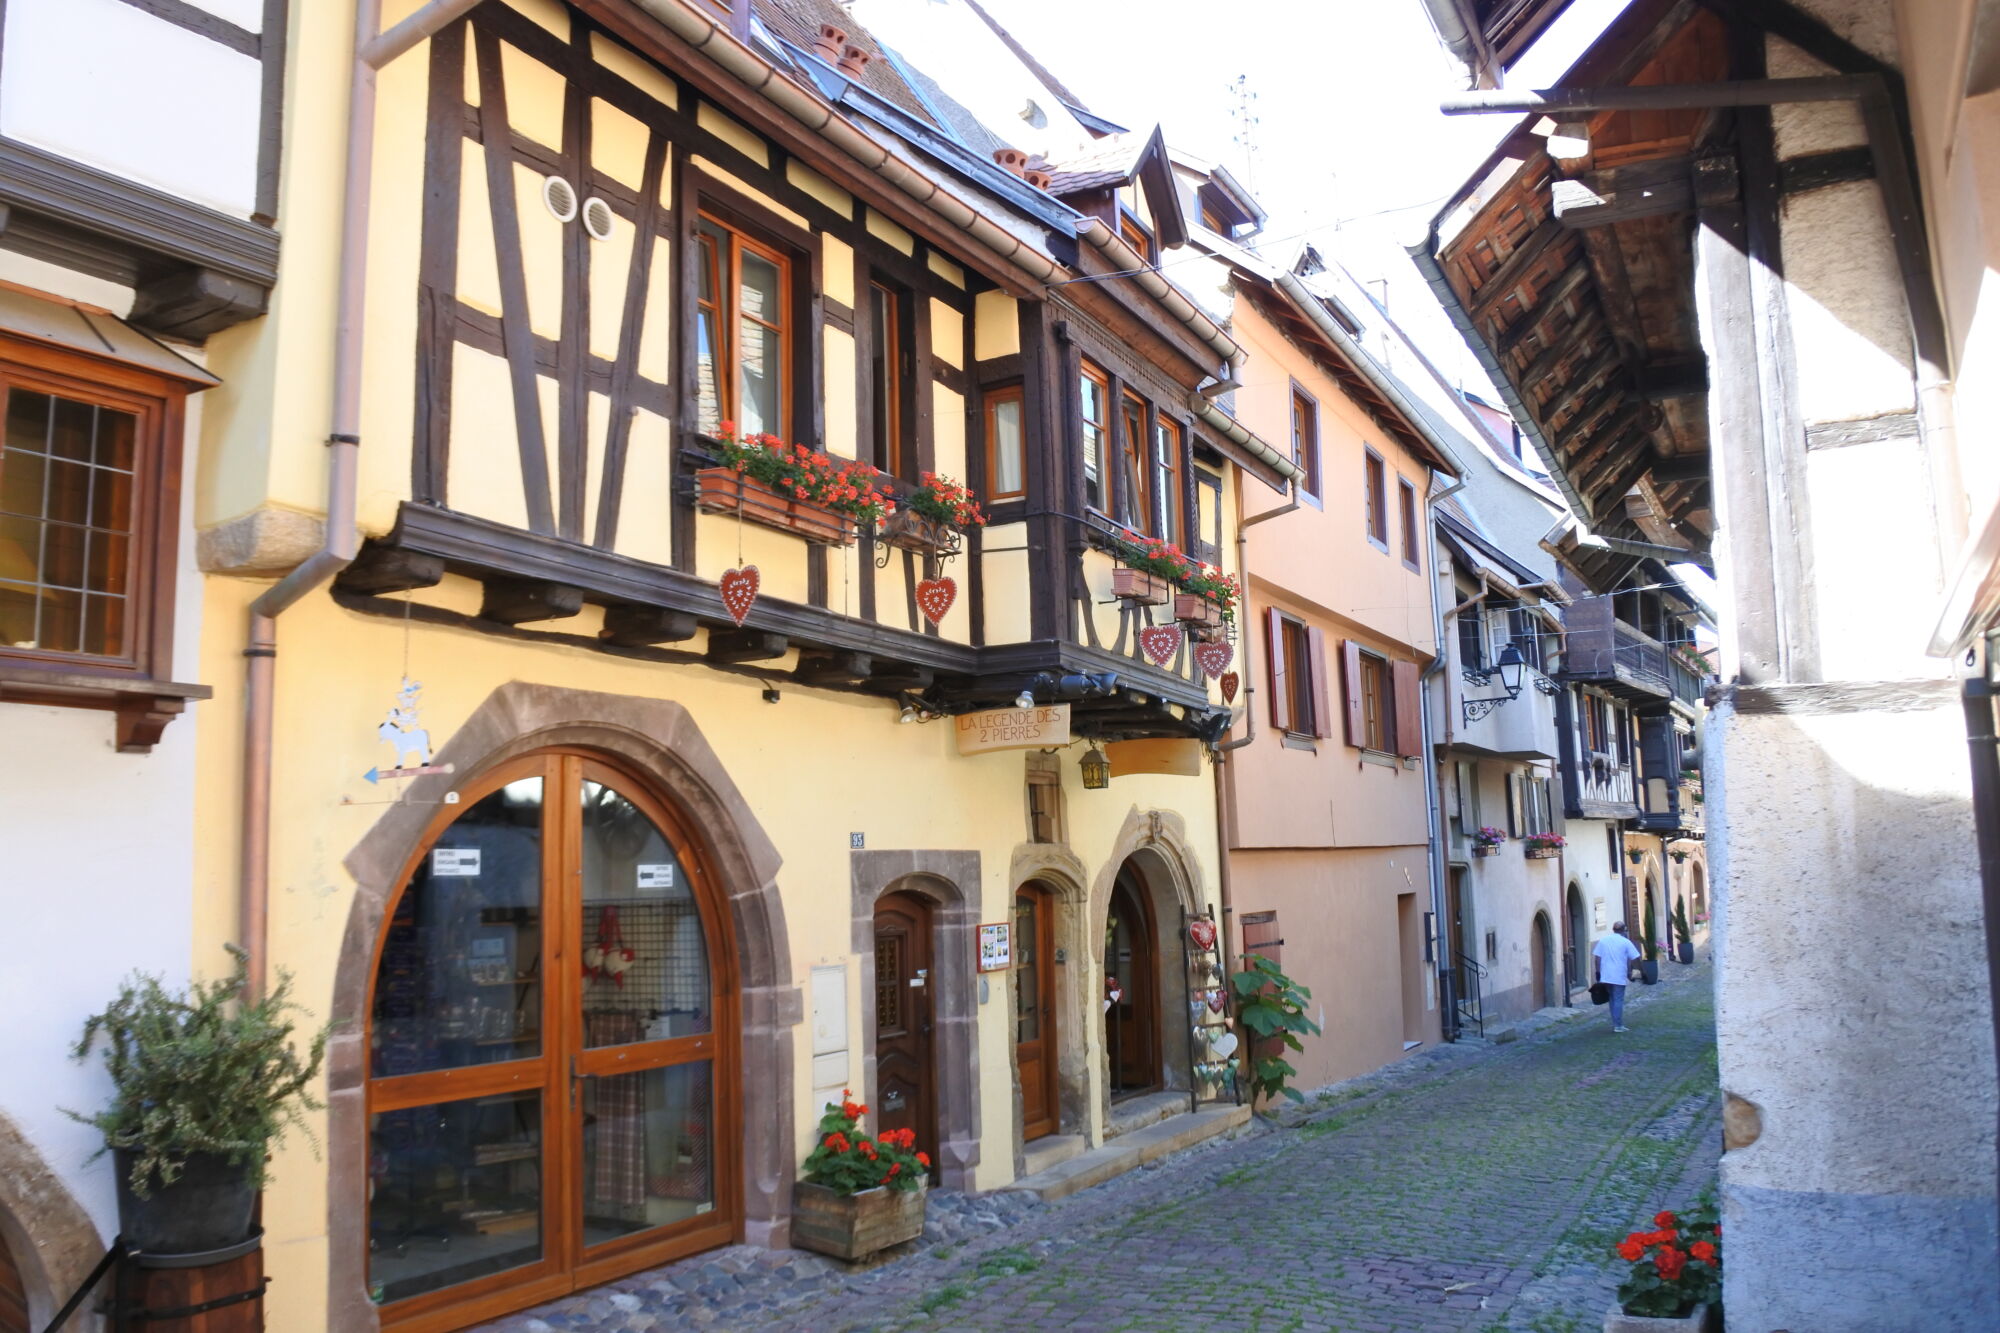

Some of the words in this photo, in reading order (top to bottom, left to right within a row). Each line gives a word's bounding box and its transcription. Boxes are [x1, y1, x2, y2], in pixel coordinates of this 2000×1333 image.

[961, 716, 976, 731] LA
[980, 710, 1034, 729] LEGENDE
[1037, 708, 1061, 723] DES
[980, 729, 988, 743] 2
[993, 725, 1040, 741] PIERRES
